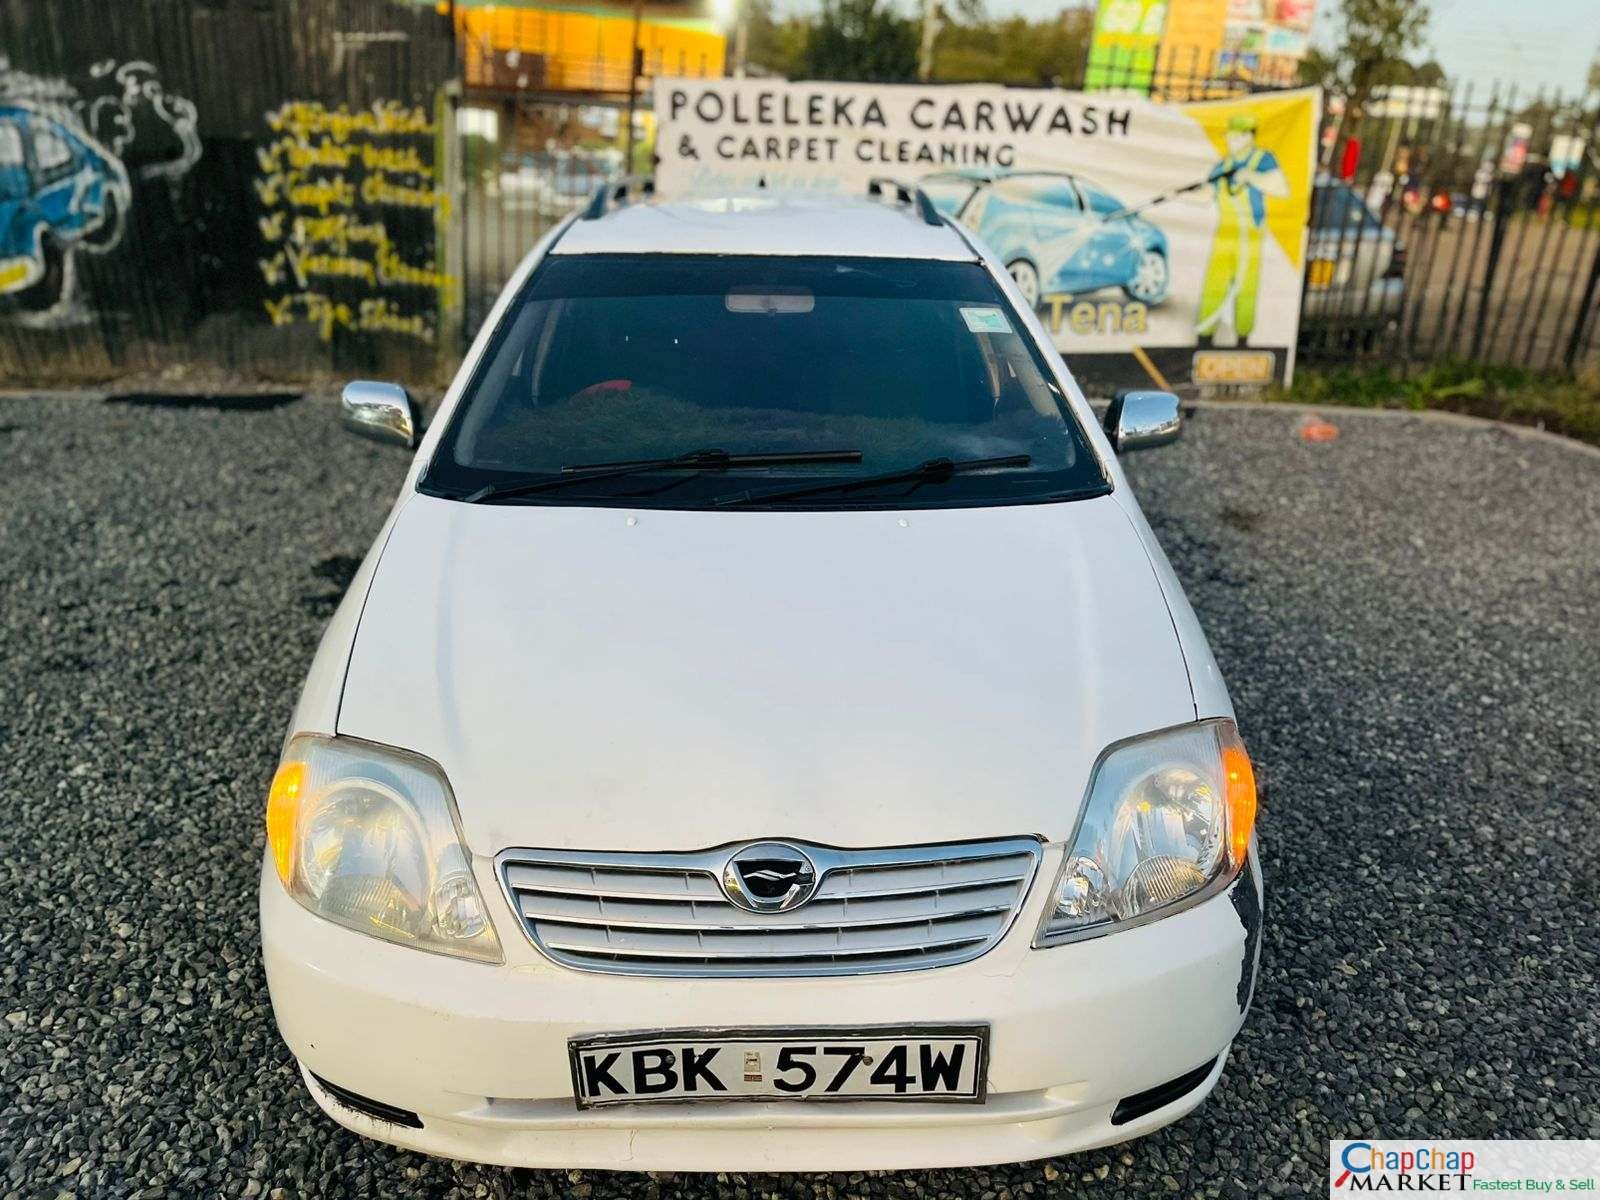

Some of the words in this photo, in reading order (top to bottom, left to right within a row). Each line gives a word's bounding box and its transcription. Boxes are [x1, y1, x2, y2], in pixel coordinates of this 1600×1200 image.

[671, 91, 888, 128] POLELEKA
[910, 98, 1133, 136] CARWASH
[677, 133, 699, 160] &
[716, 135, 839, 162] CARPET
[854, 139, 1015, 168] CLEANING
[1043, 294, 1149, 335] Tena
[582, 1047, 728, 1097] KBK
[773, 1043, 966, 1094] 574W
